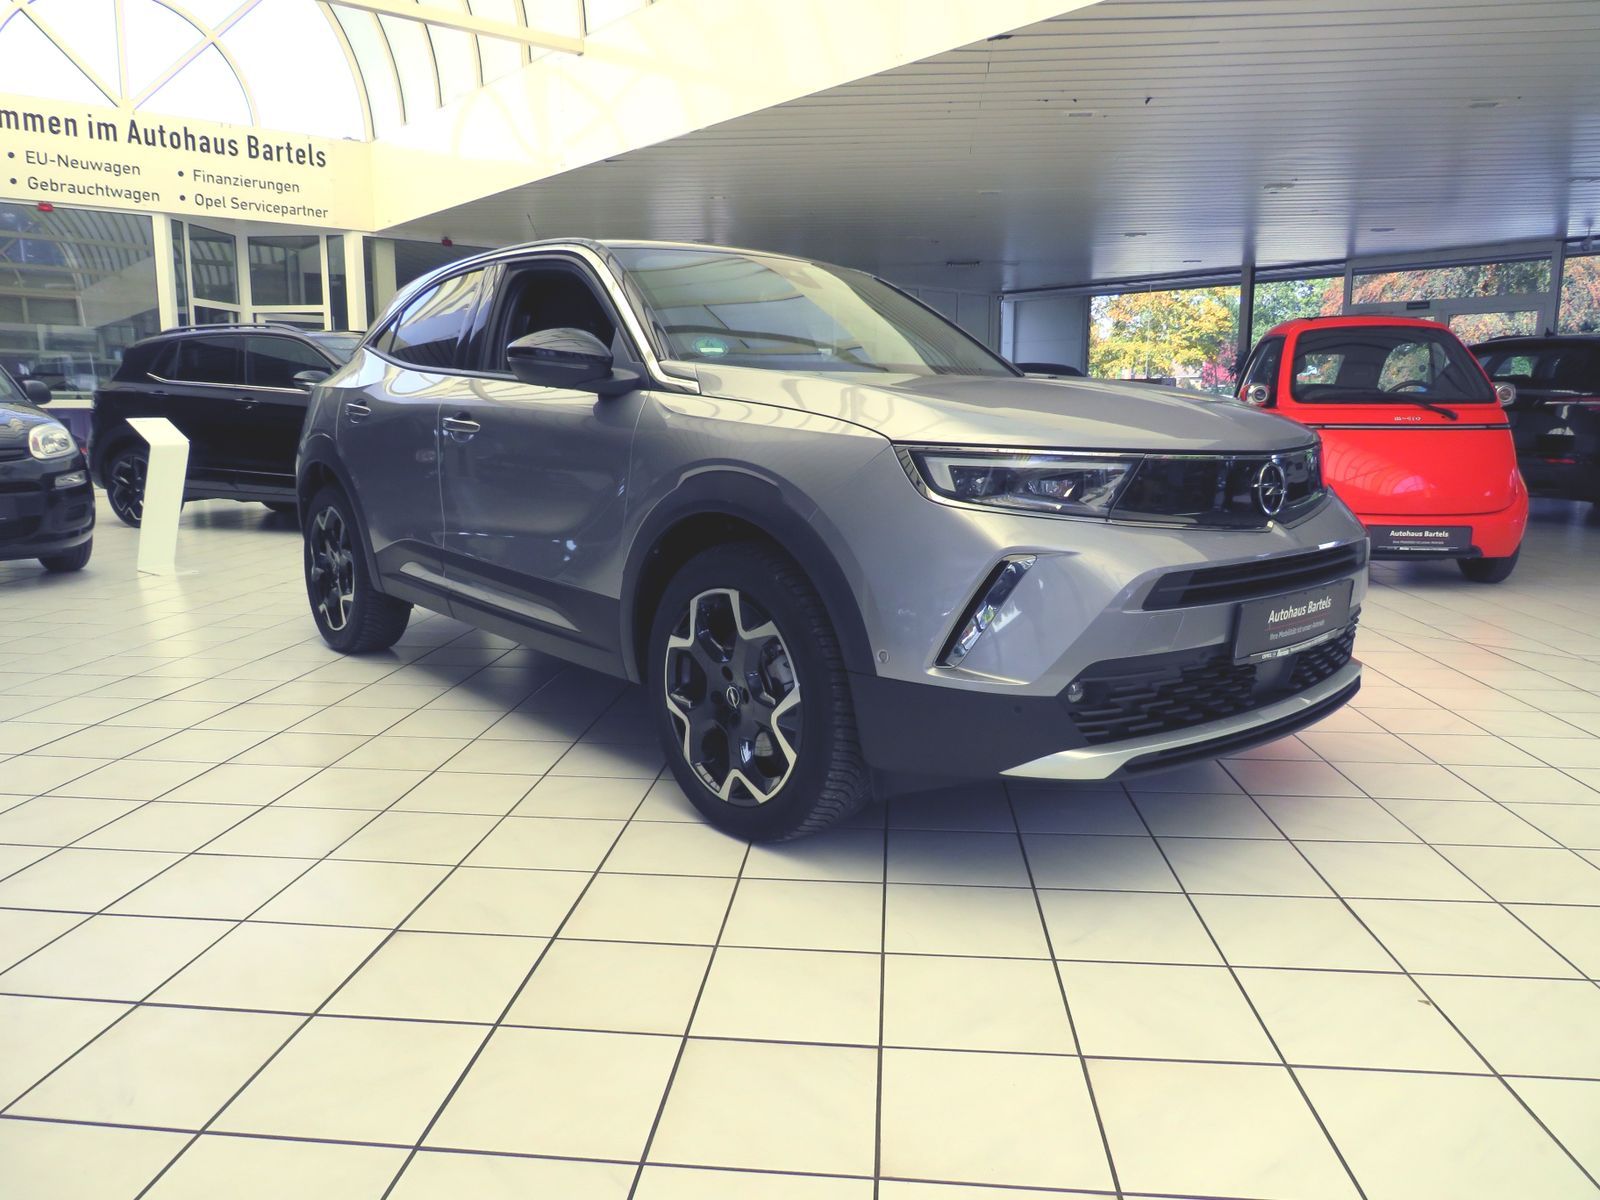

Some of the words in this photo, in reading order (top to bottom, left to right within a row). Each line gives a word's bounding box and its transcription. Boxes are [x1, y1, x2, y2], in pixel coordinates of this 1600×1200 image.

[87, 113, 118, 142] im
[127, 118, 240, 157] Autohaus
[247, 135, 327, 168] Bartels
[25, 150, 141, 177] EU-Neuwagen
[27, 176, 161, 203] Gebrauchtwagen
[193, 169, 300, 194] Finanzierungen
[194, 193, 227, 210] Opel
[230, 196, 329, 219] Servicepartner
[1389, 530, 1423, 538] Autohaus
[1424, 530, 1449, 538] Bartels
[1267, 605, 1307, 624] Autohaus
[1307, 595, 1332, 614] Bartels
